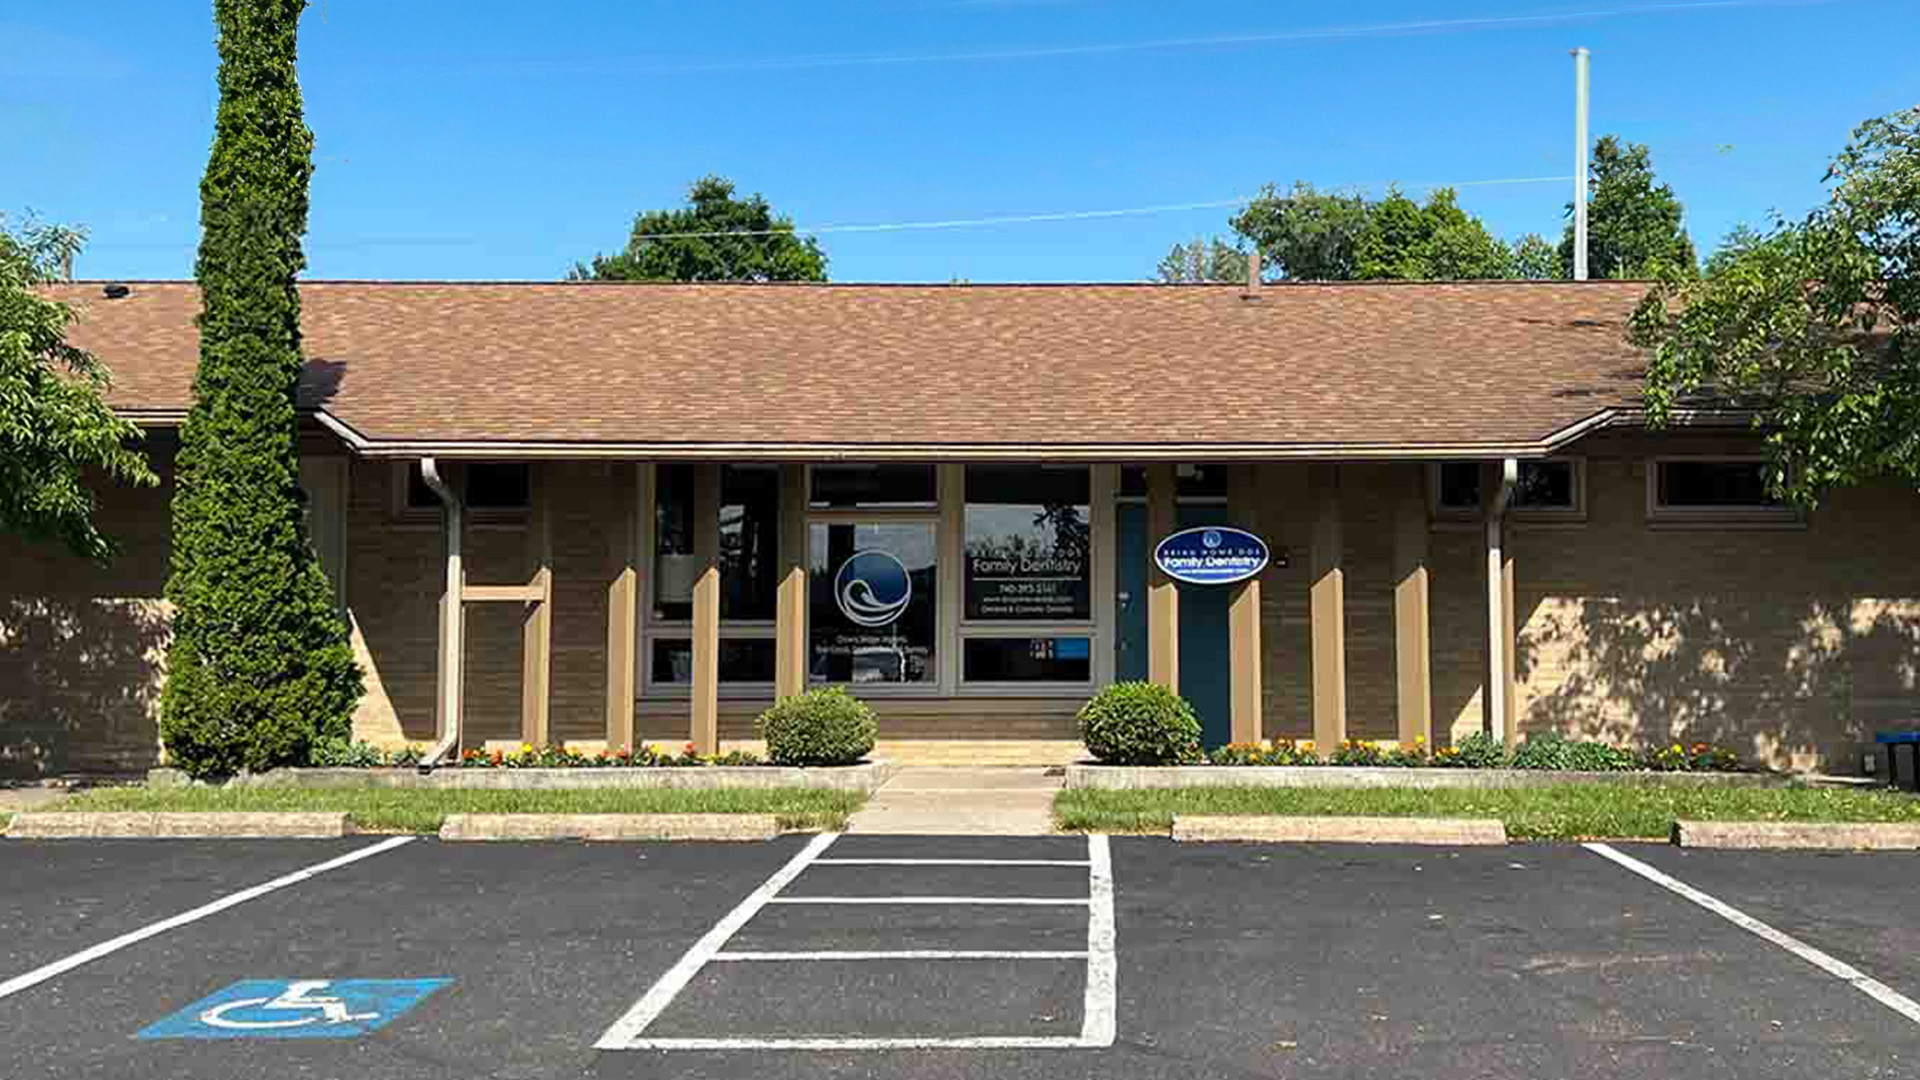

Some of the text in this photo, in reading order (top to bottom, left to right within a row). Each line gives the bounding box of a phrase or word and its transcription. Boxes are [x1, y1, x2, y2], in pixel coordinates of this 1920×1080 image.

[973, 559, 1081, 574] Family Dentistry
[1163, 557, 1261, 568] Family Dentistry
